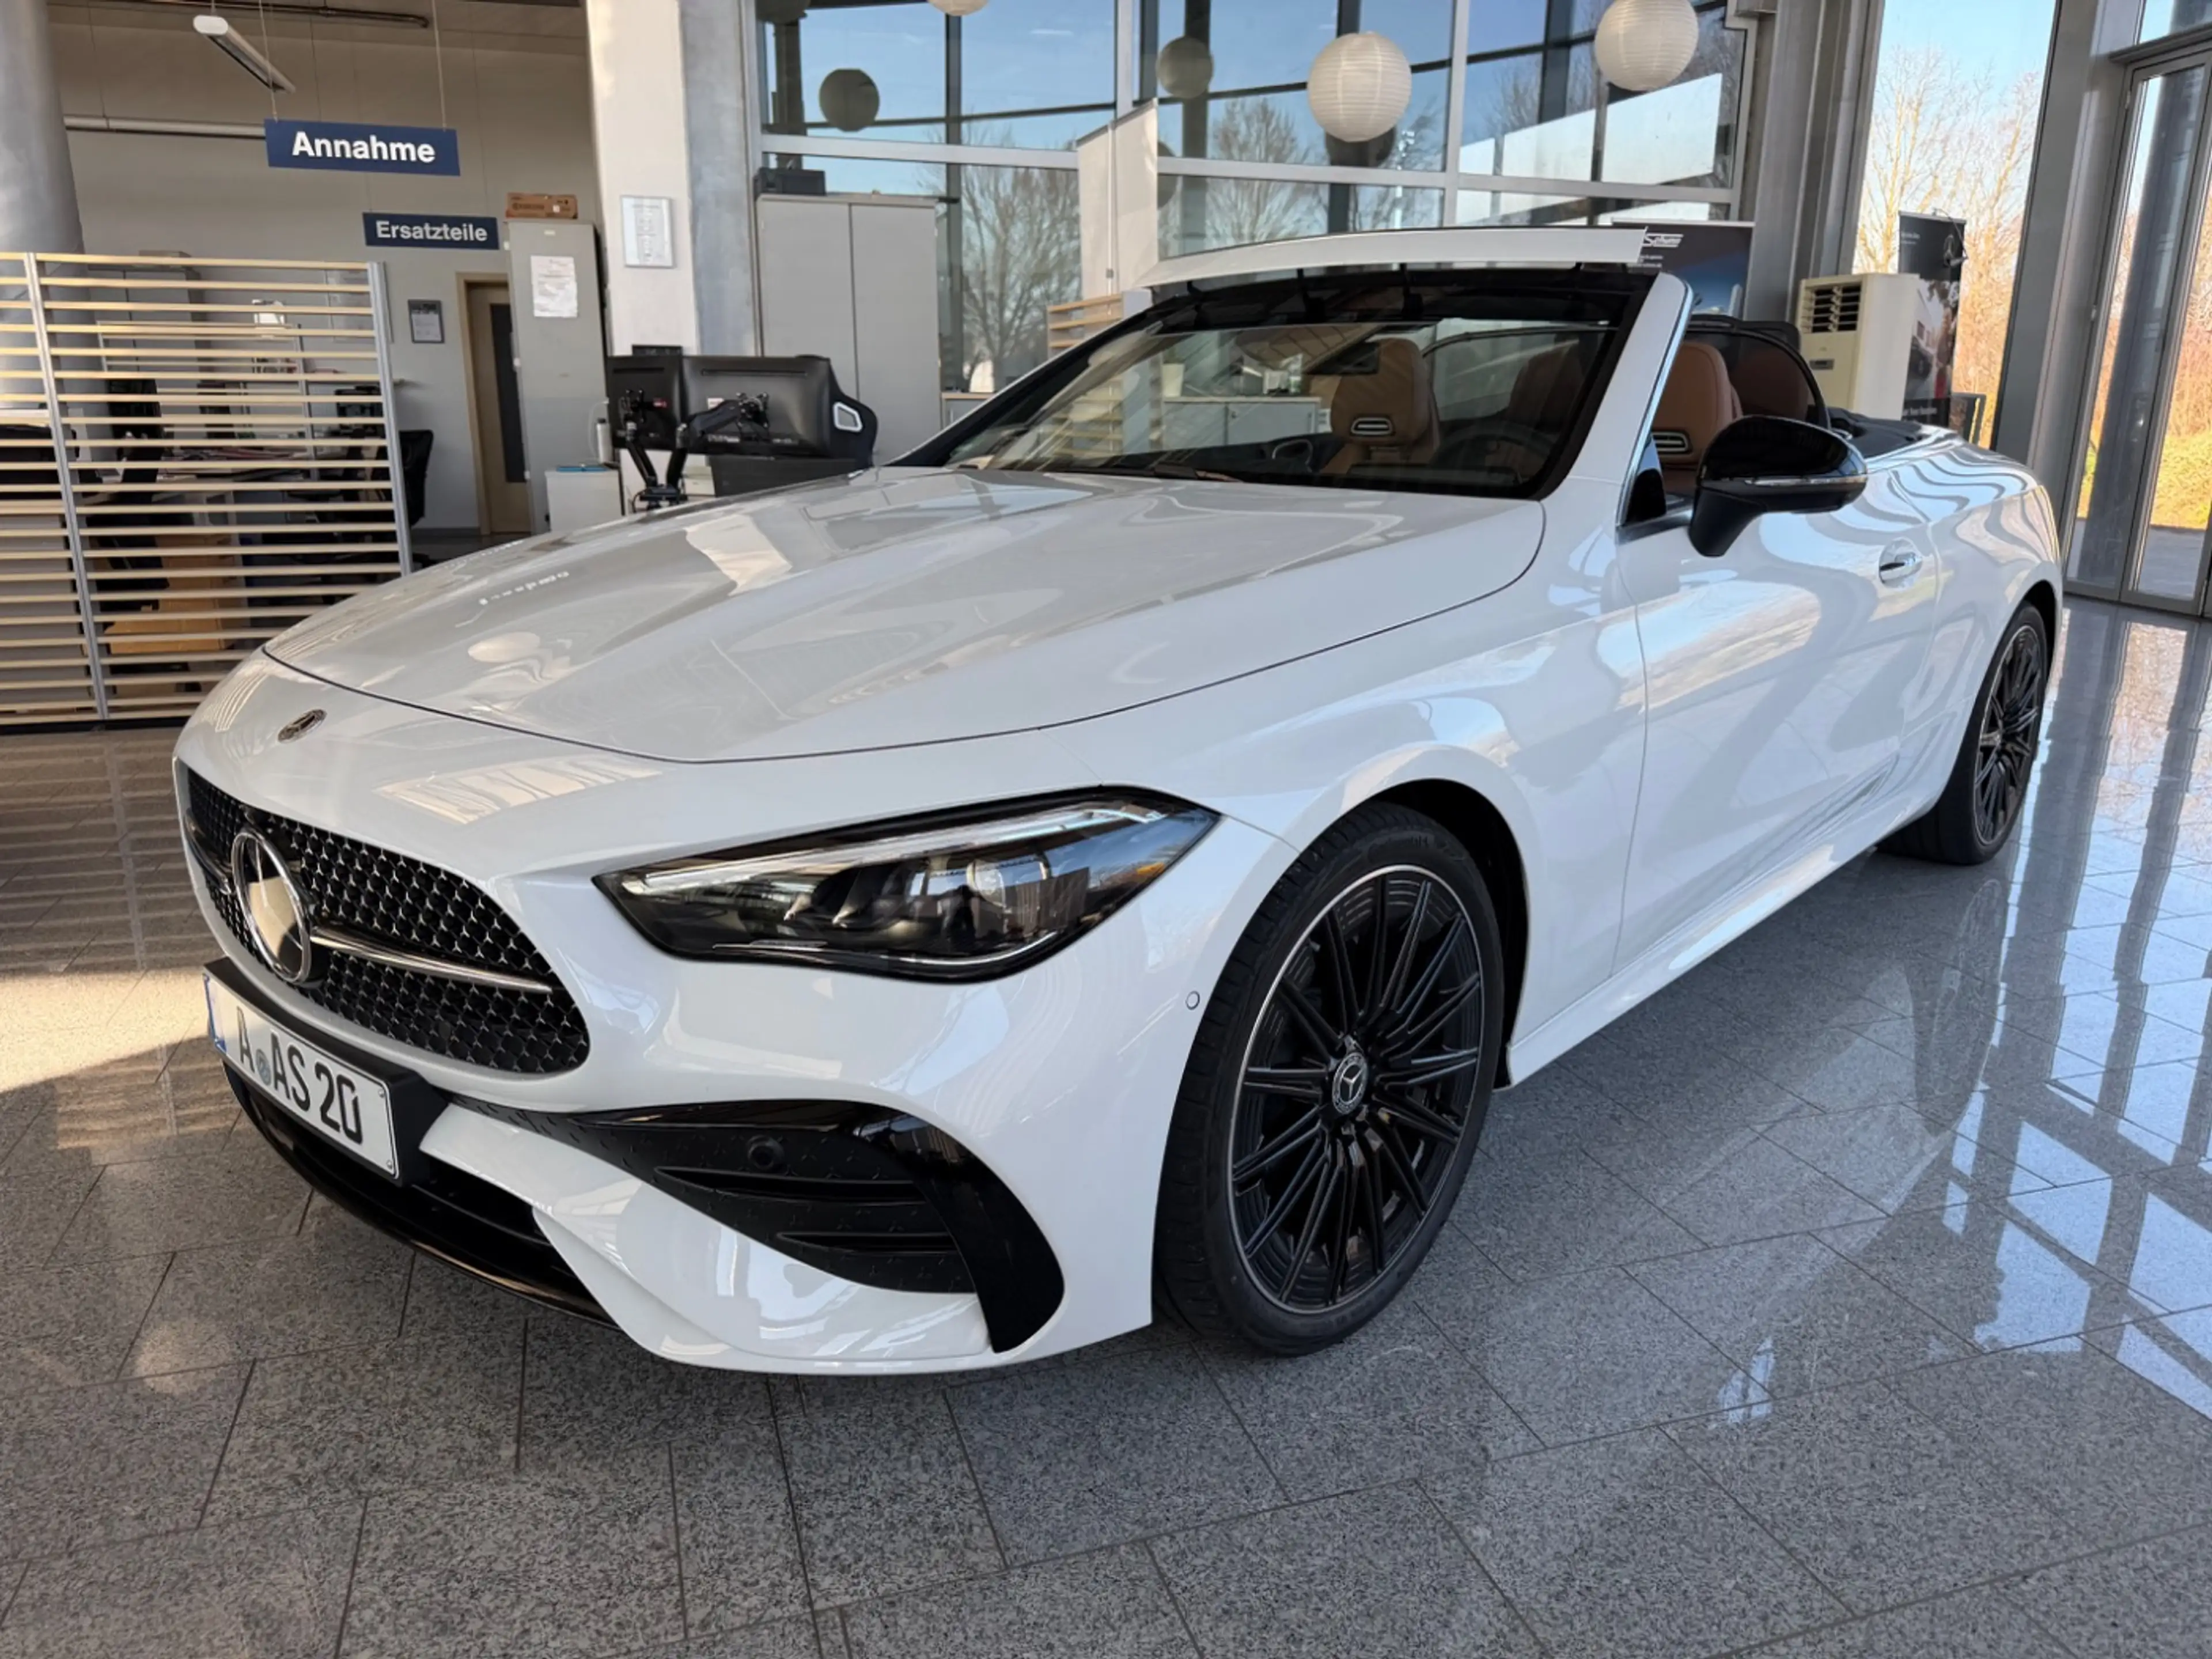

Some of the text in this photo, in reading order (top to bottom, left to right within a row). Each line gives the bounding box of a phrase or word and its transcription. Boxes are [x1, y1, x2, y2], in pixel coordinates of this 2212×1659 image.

[292, 131, 436, 163] Annahme
[376, 219, 488, 241] Ersatzteile
[236, 1006, 363, 1145] A AS 20
